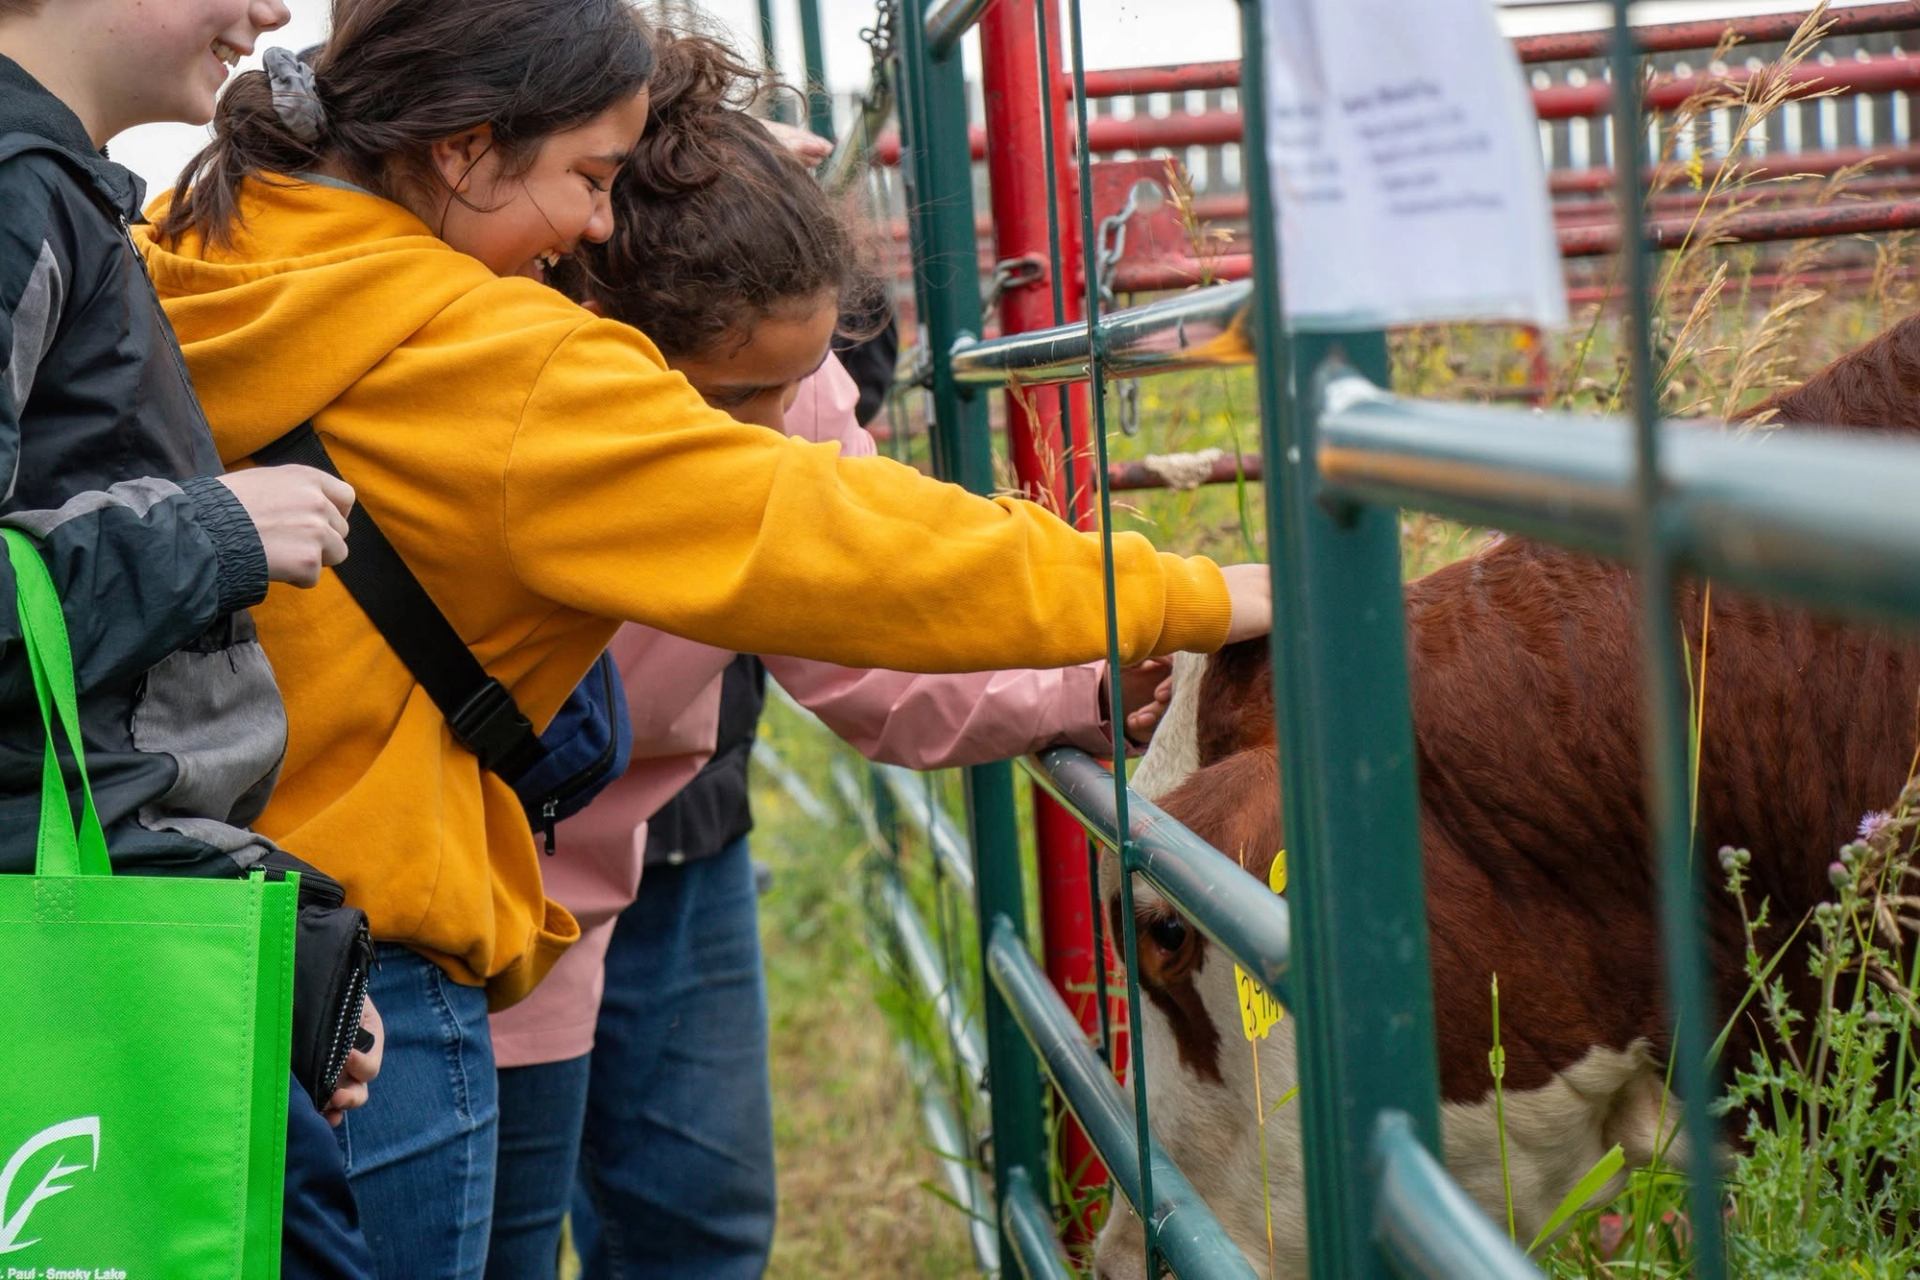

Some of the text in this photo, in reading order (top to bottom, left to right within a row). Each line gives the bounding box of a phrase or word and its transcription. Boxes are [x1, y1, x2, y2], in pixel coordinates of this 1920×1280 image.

[7, 1268, 36, 1280] Paul
[46, 1268, 91, 1280] Smoky
[94, 1268, 127, 1280] Lake
